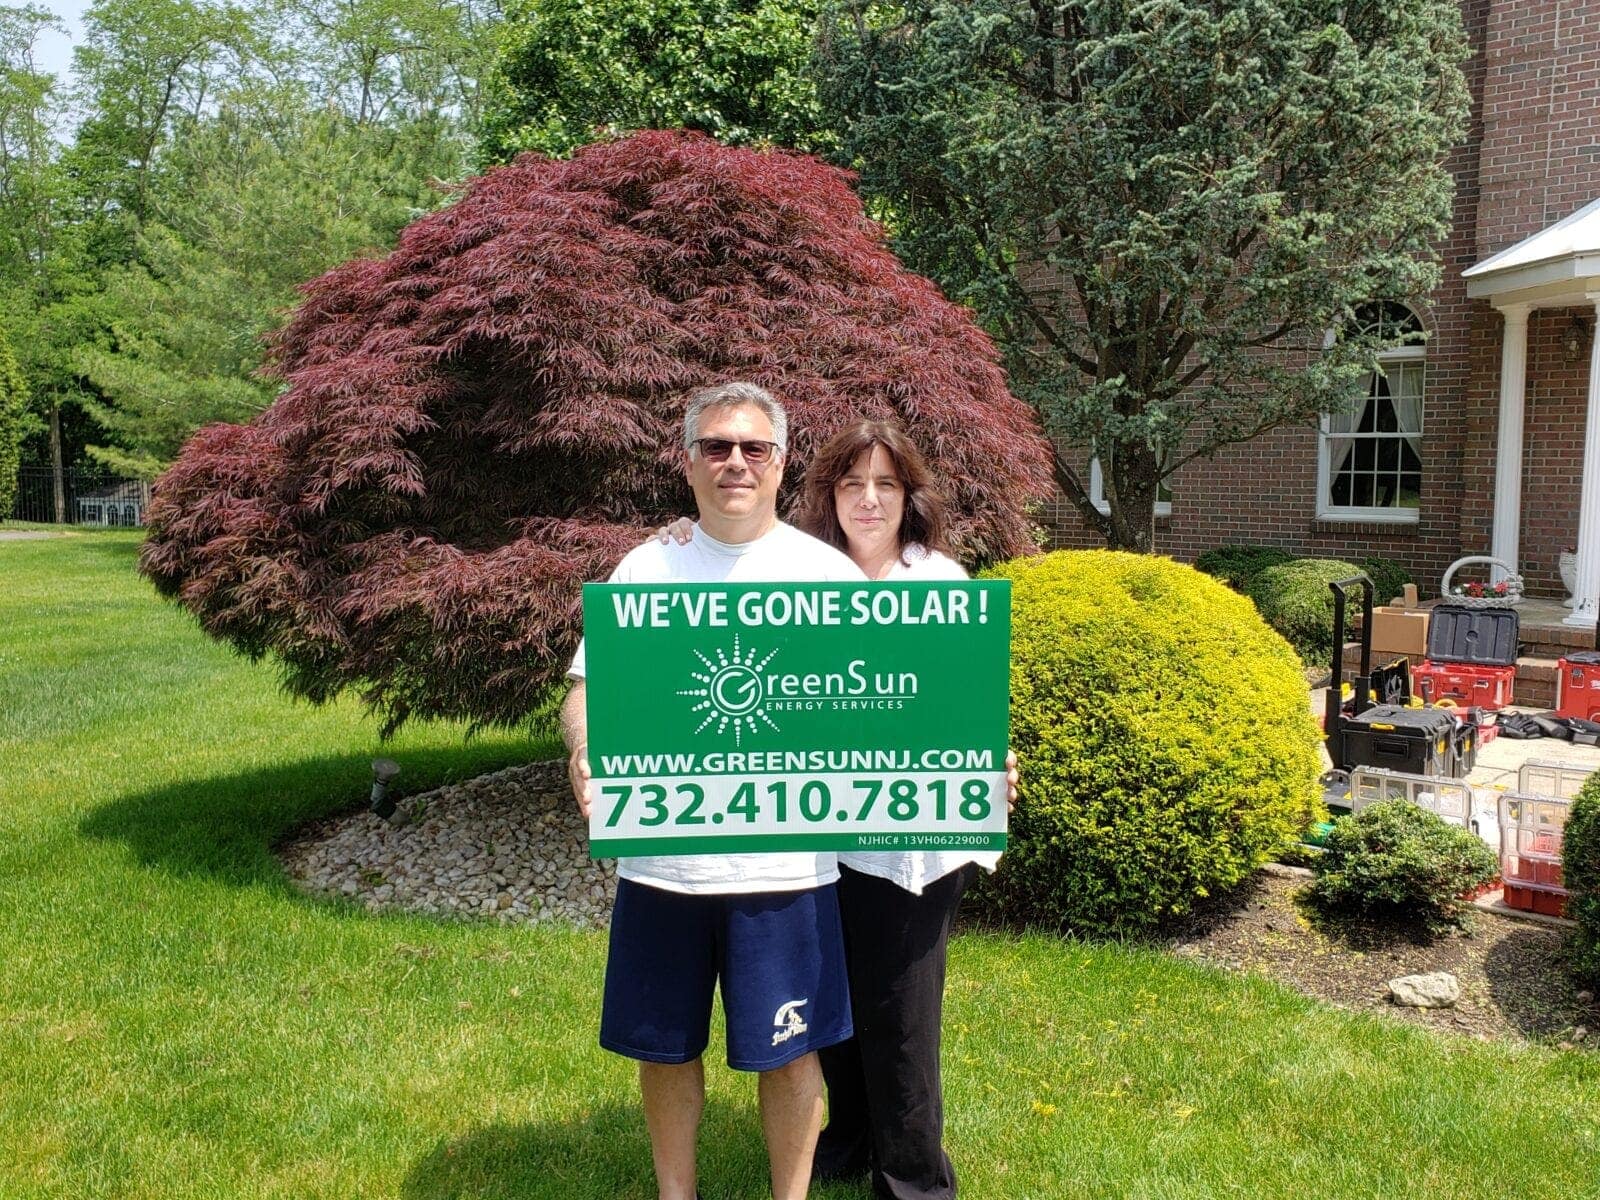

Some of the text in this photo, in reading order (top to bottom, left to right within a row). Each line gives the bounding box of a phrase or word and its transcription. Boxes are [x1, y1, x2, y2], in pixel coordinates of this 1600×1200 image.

[611, 592, 729, 628] WE'VE
[737, 590, 841, 626] GONE
[850, 589, 970, 625] SOLAR
[766, 700, 904, 712] ENERGY SERVICES
[600, 749, 994, 775] WWW.GREENSUNNJ.COM
[601, 778, 991, 828] 732.410.7818
[858, 835, 990, 846] NJHIC# 13VH06229000
